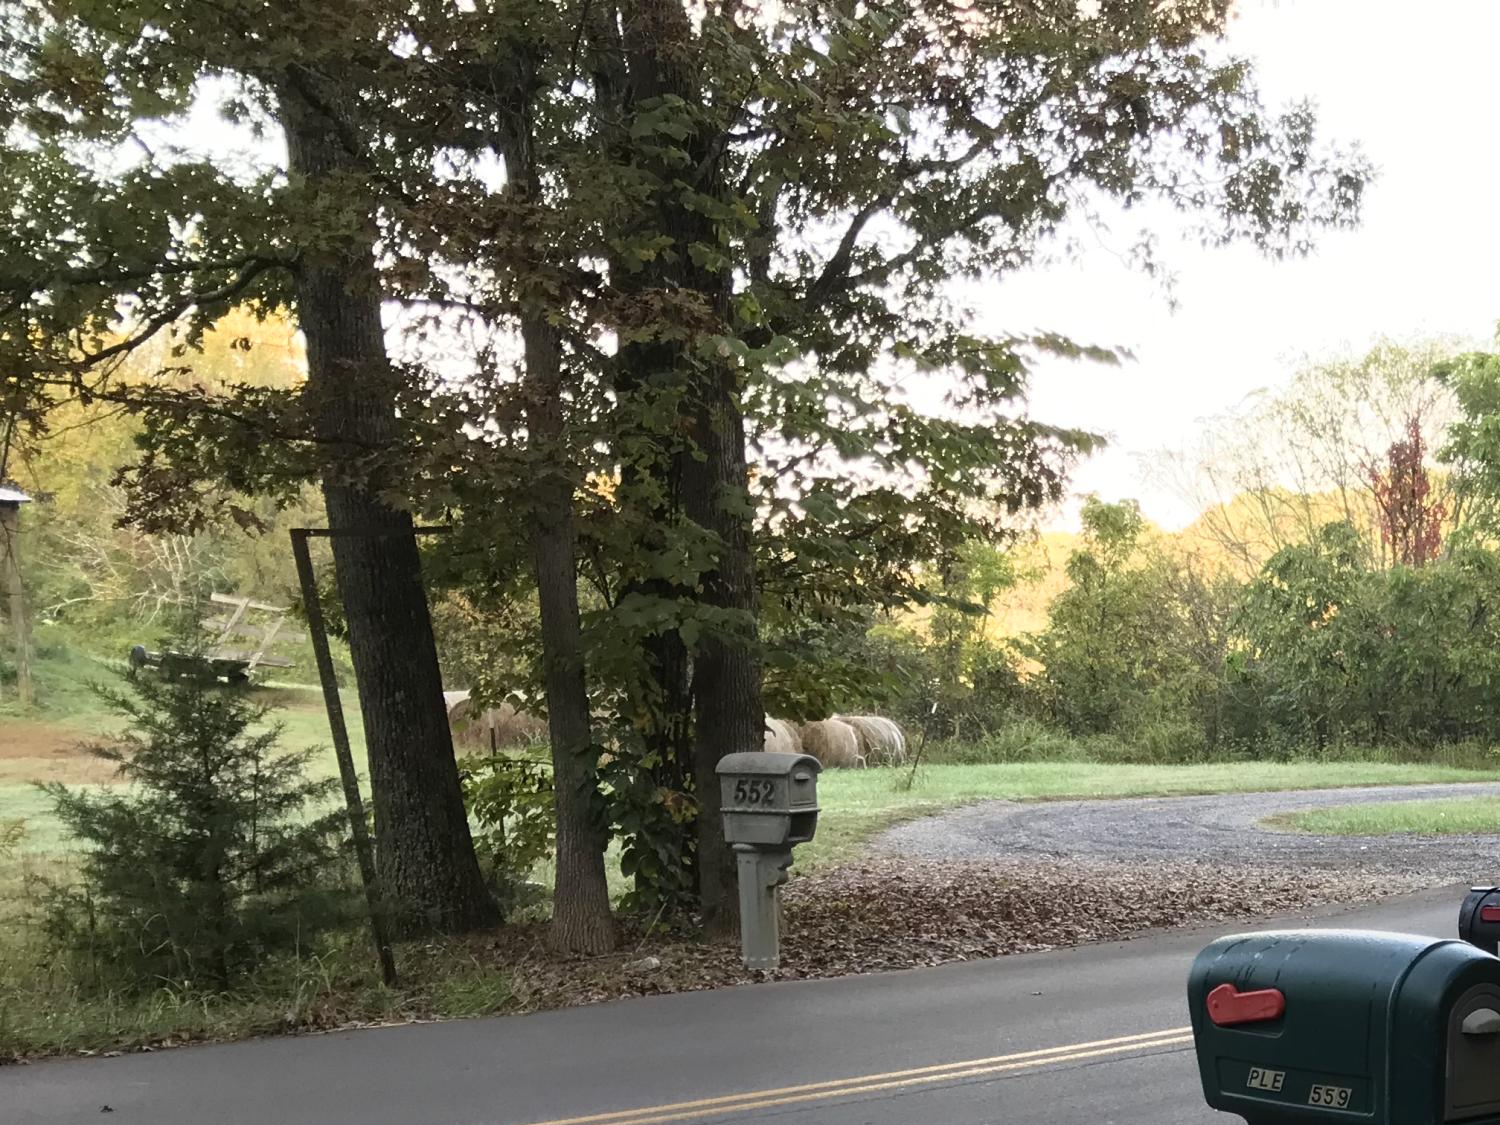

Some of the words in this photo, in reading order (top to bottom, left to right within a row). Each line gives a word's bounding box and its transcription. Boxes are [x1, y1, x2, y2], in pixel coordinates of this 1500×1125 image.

[734, 780, 775, 805] 552
[1249, 1070, 1283, 1089] PLE
[1311, 1087, 1349, 1106] 559
